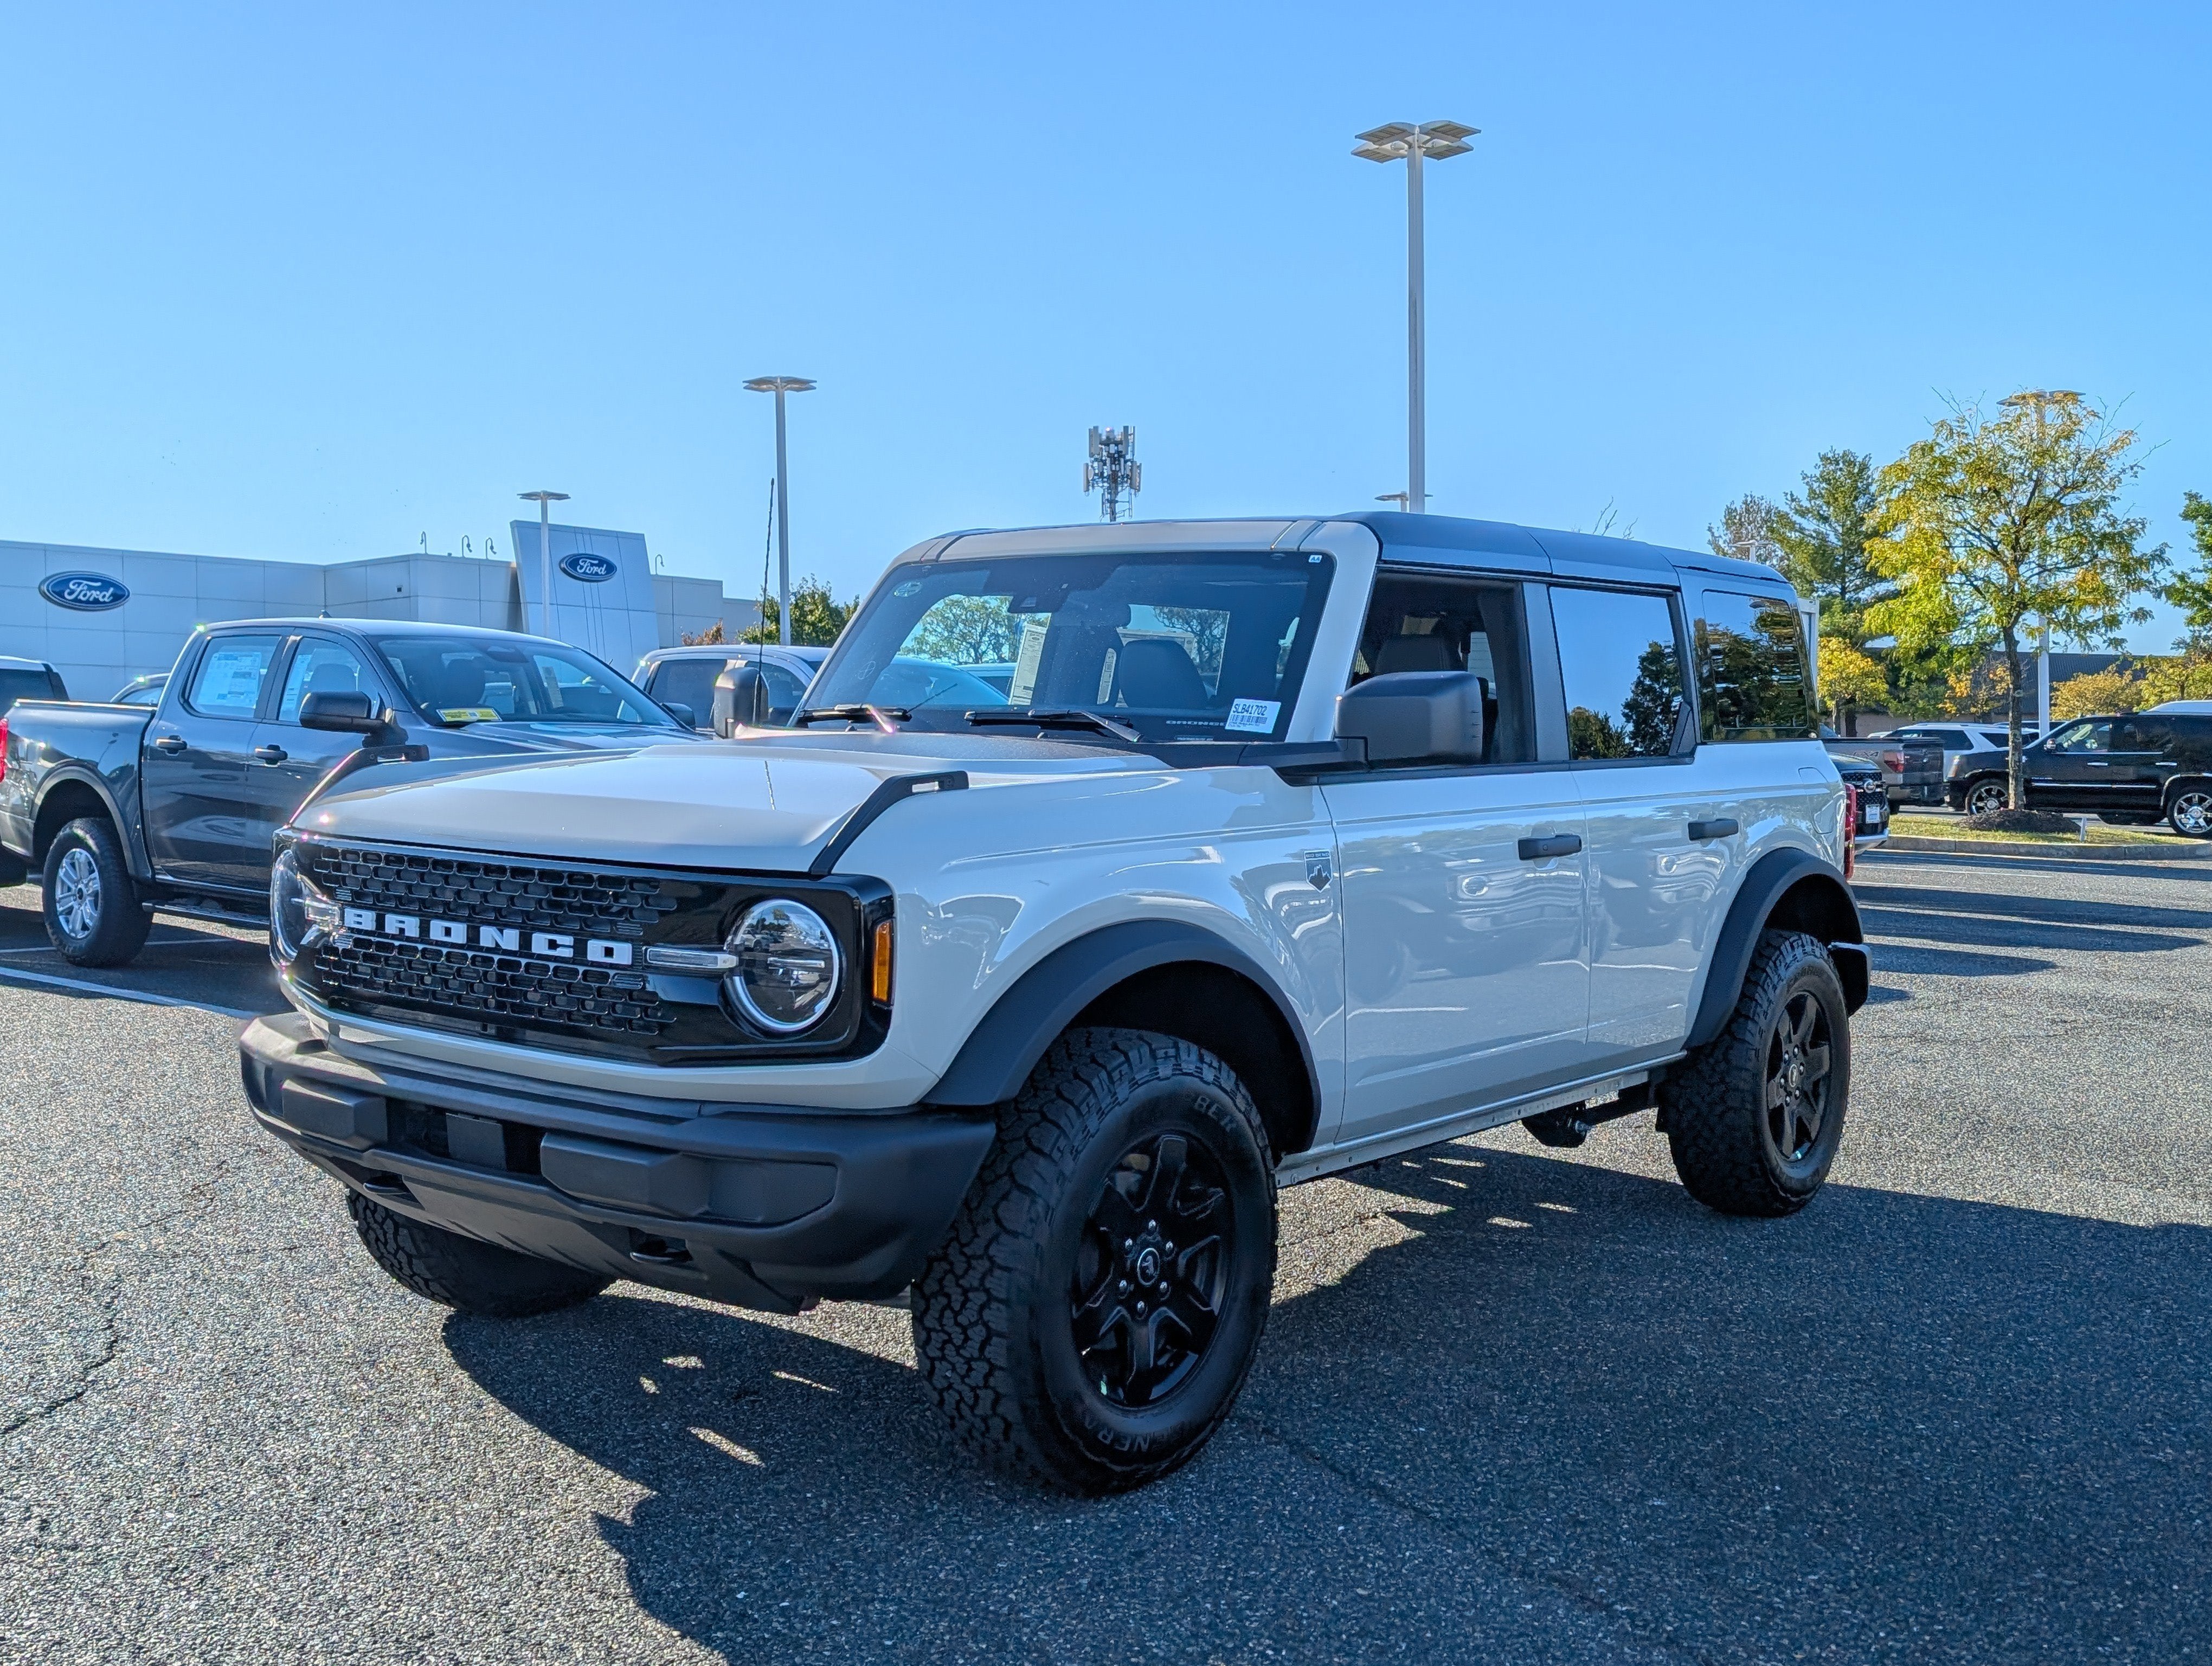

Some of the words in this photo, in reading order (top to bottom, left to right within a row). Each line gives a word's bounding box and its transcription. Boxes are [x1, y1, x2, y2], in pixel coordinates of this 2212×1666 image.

[576, 559, 607, 575] Ford
[64, 579, 114, 602] Ford
[1232, 703, 1268, 716] SLB41702
[344, 906, 633, 965] BRONCO
